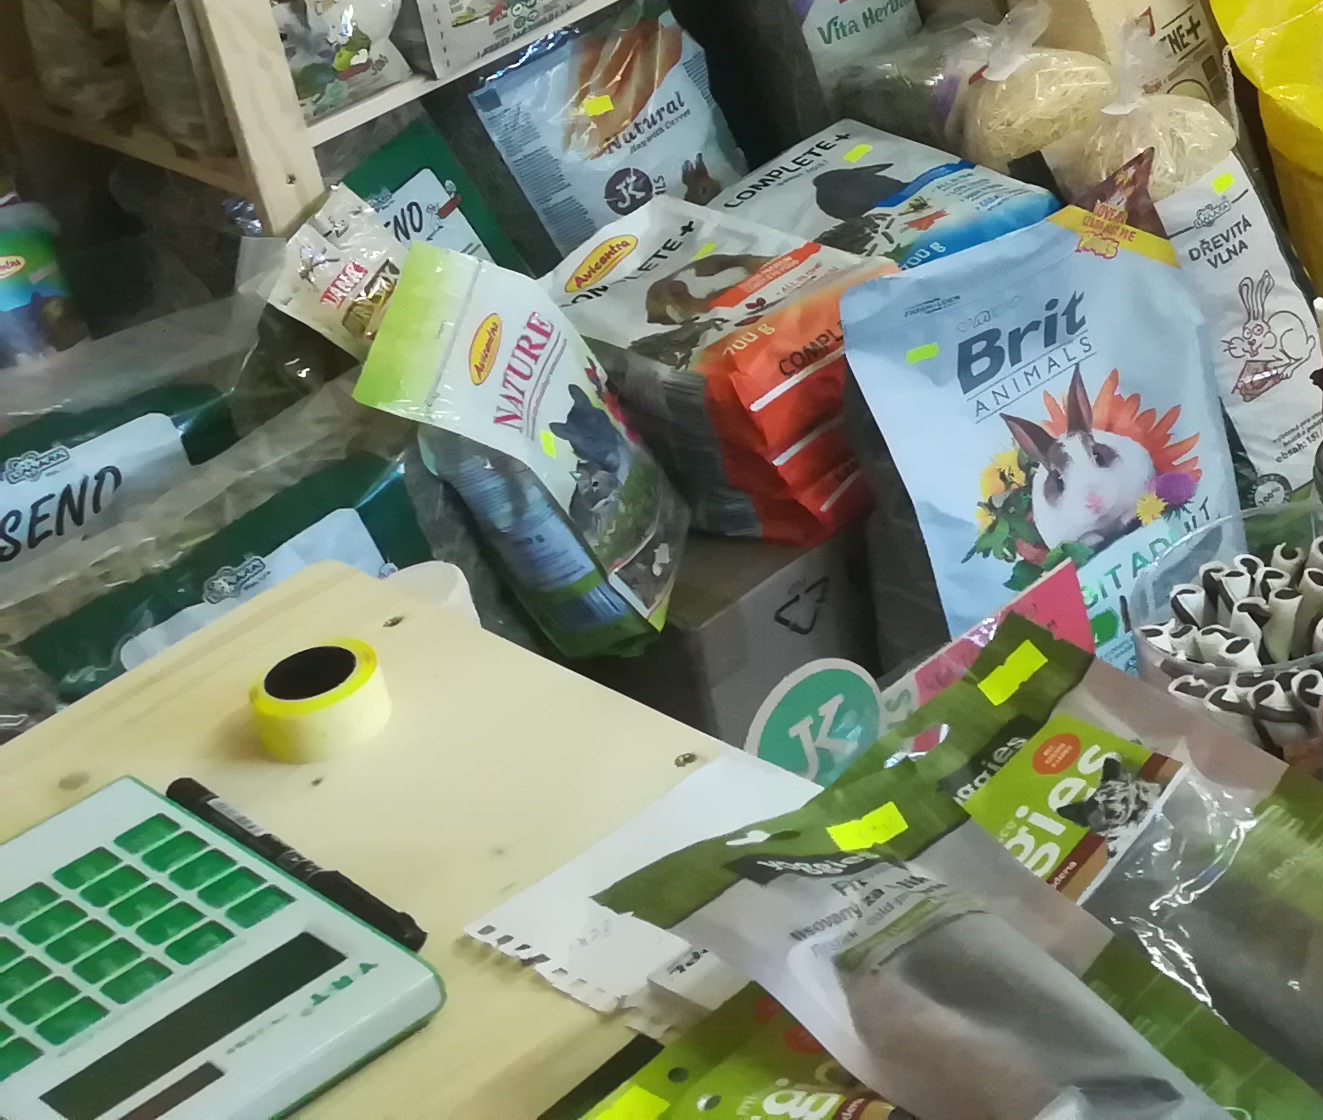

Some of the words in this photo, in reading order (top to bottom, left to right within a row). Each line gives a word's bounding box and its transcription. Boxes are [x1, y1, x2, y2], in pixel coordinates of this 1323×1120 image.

[817, 15, 859, 46] Vita
[606, 91, 686, 156] Natural
[1188, 215, 1253, 263] DŘEVITÁ
[1206, 239, 1250, 270] VLNA
[723, 332, 758, 357] 700
[779, 320, 845, 380] COMPL
[957, 291, 1087, 394] Brit
[493, 313, 556, 433] NATURE
[975, 336, 1094, 419] ANIMALS
